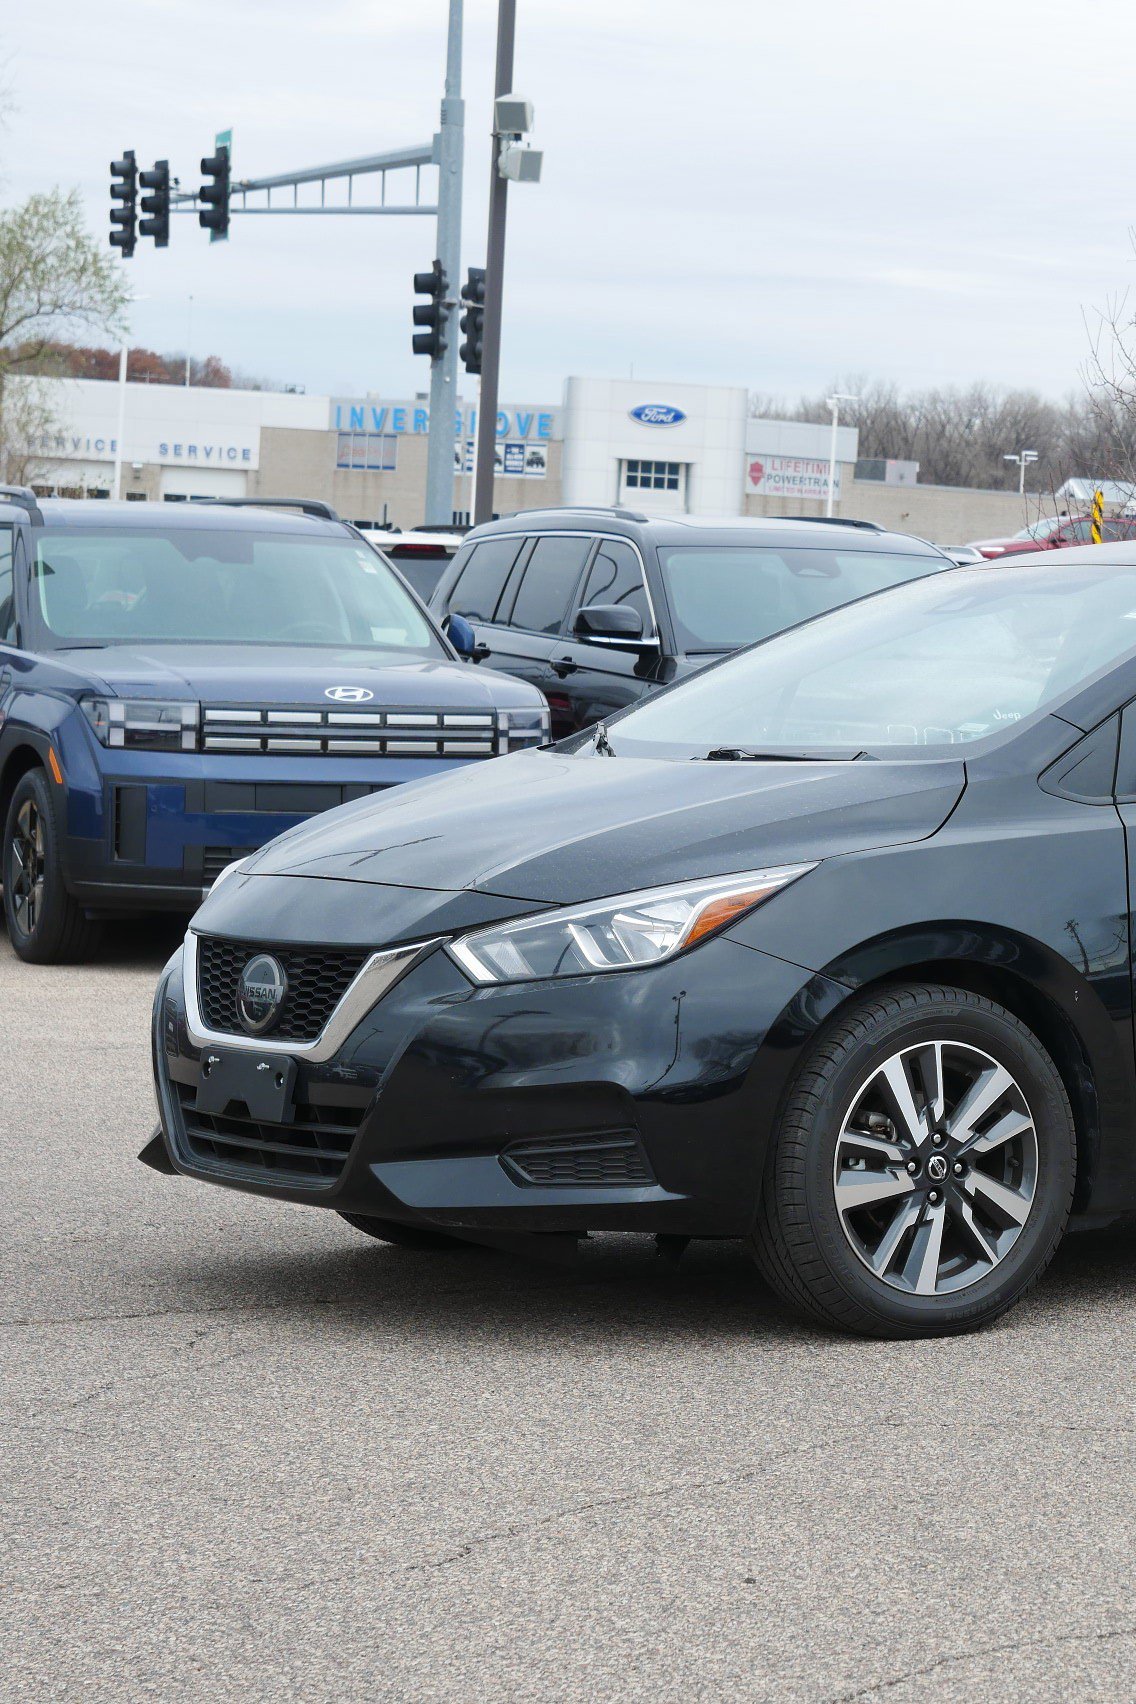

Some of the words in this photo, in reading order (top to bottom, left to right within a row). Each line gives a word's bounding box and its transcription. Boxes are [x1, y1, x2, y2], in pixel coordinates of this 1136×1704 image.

[335, 405, 428, 432] INVER
[641, 408, 675, 422] Ford
[159, 443, 252, 461] SERVICE
[765, 474, 840, 489] POWERTRAN
[993, 709, 1021, 721] Jeep
